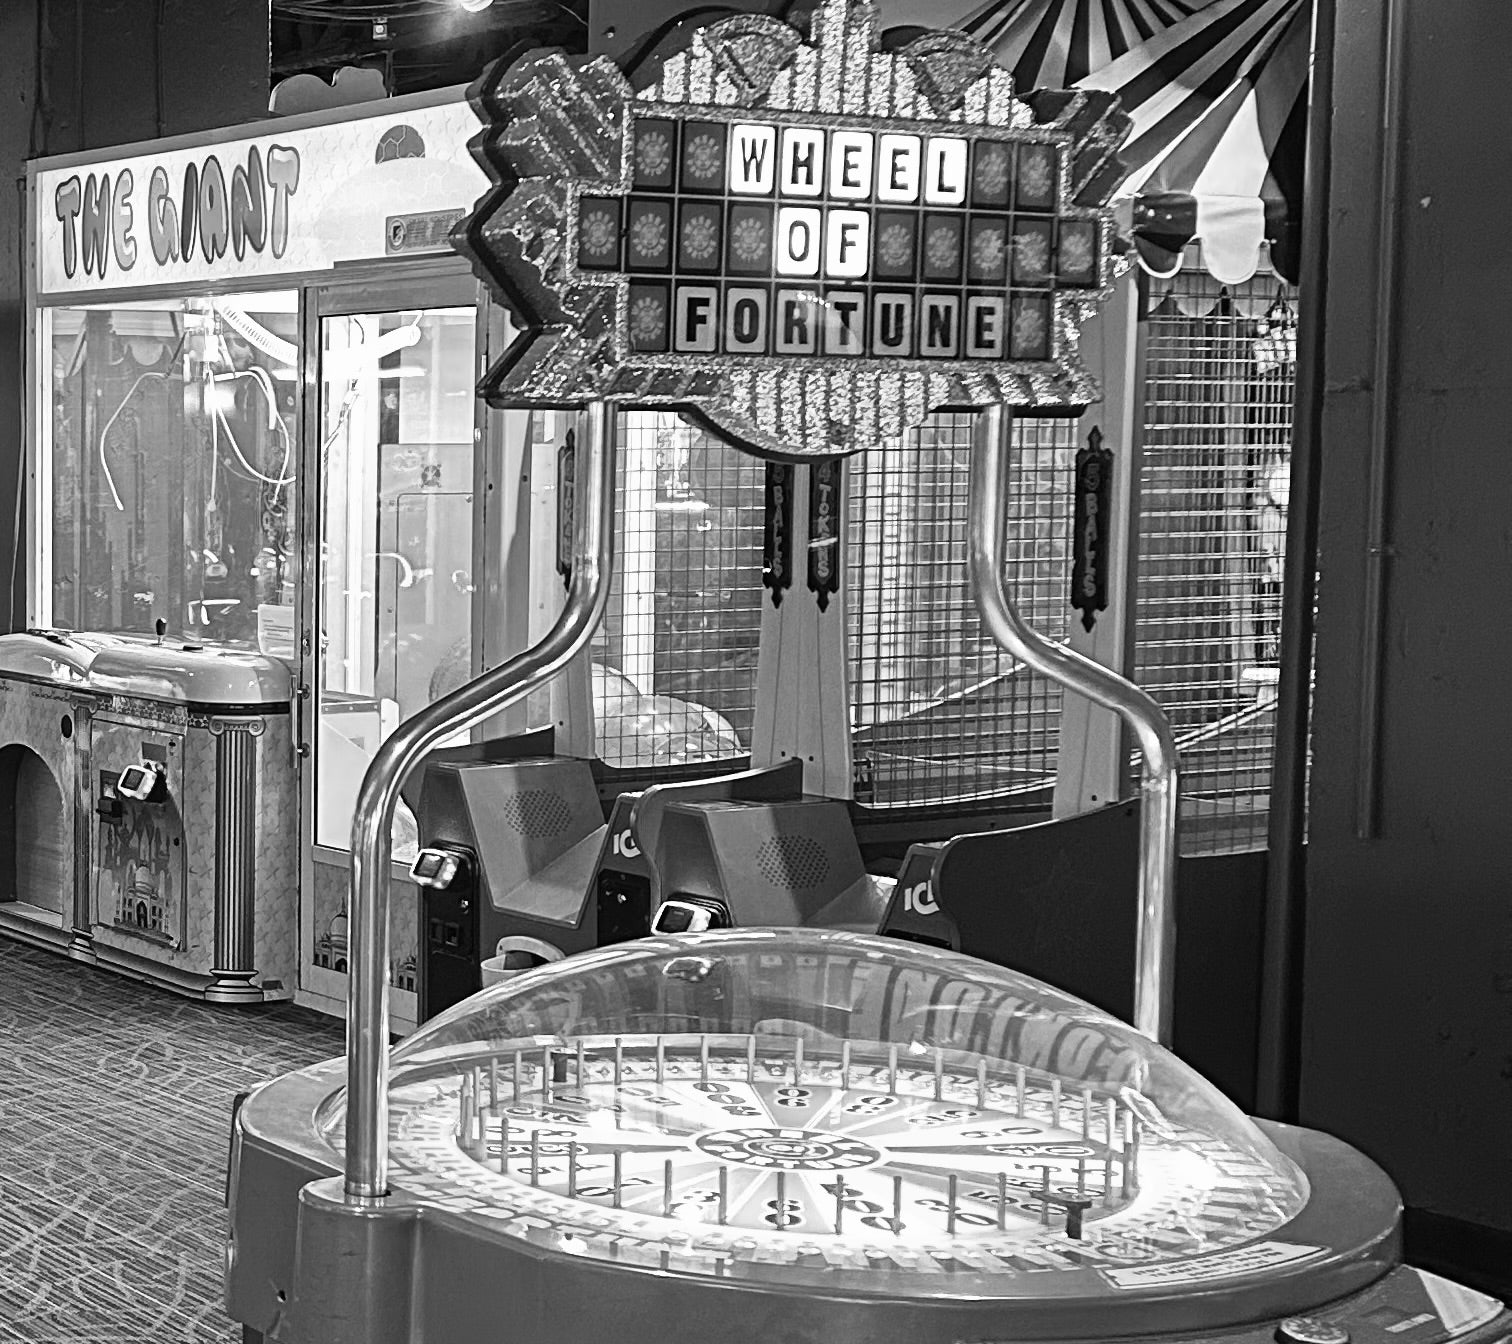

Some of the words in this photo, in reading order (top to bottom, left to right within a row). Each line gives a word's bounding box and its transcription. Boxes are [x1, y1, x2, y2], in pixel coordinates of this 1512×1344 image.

[740, 137, 958, 194] WHEEL
[54, 164, 137, 280] THE
[149, 144, 301, 268] GIANT
[788, 220, 859, 264] OF
[686, 297, 997, 351] FORTUNE
[613, 829, 641, 857] IC
